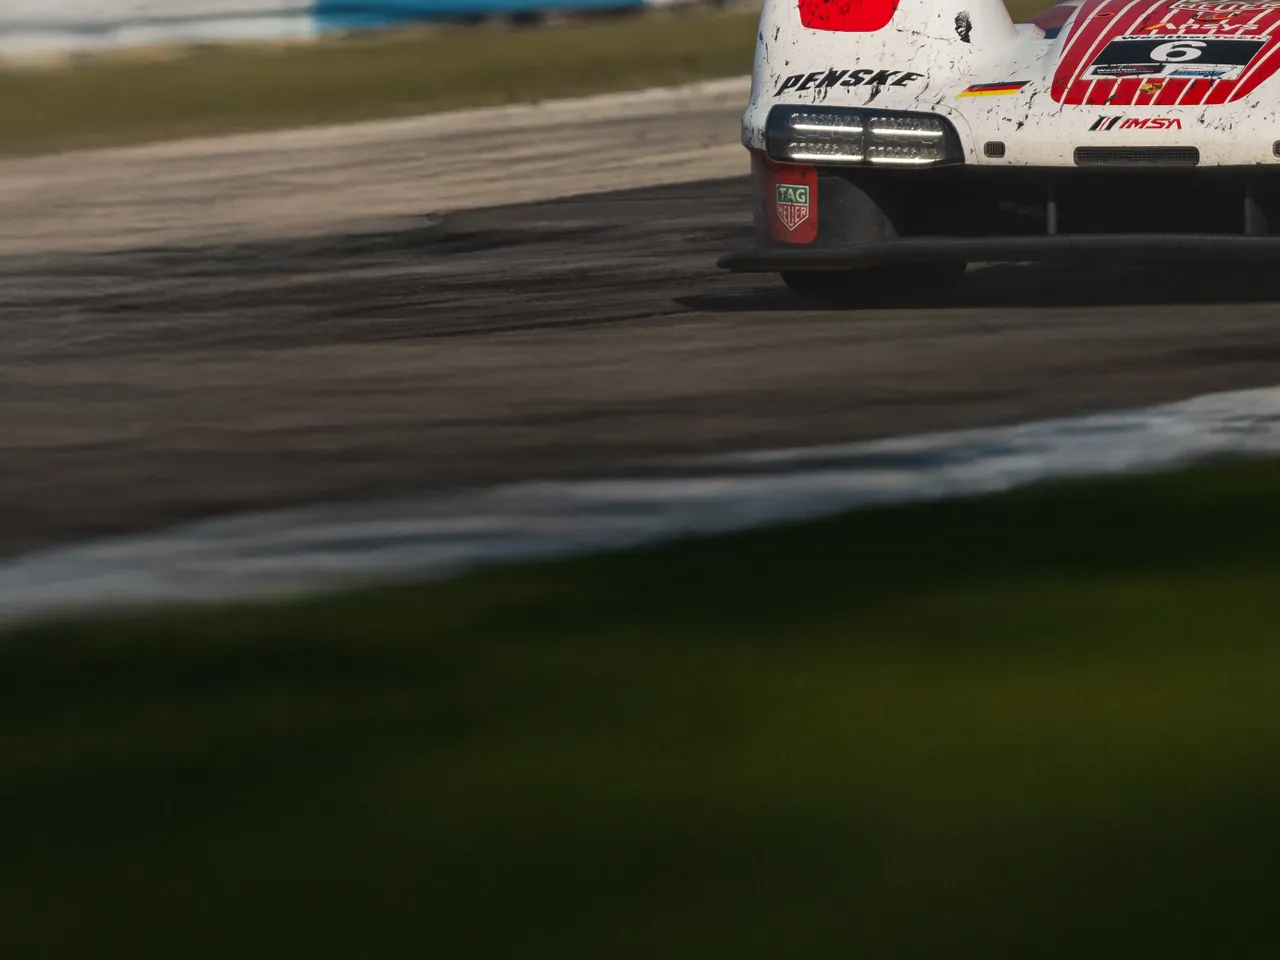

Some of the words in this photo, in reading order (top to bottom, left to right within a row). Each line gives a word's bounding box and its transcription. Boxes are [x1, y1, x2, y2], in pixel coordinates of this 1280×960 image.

[1145, 22, 1259, 31] Ansys
[1150, 40, 1208, 62] 6
[773, 69, 925, 97] PENSKE
[1119, 117, 1182, 130] IMSA
[779, 187, 806, 202] TAG
[778, 204, 807, 227] HEUER
